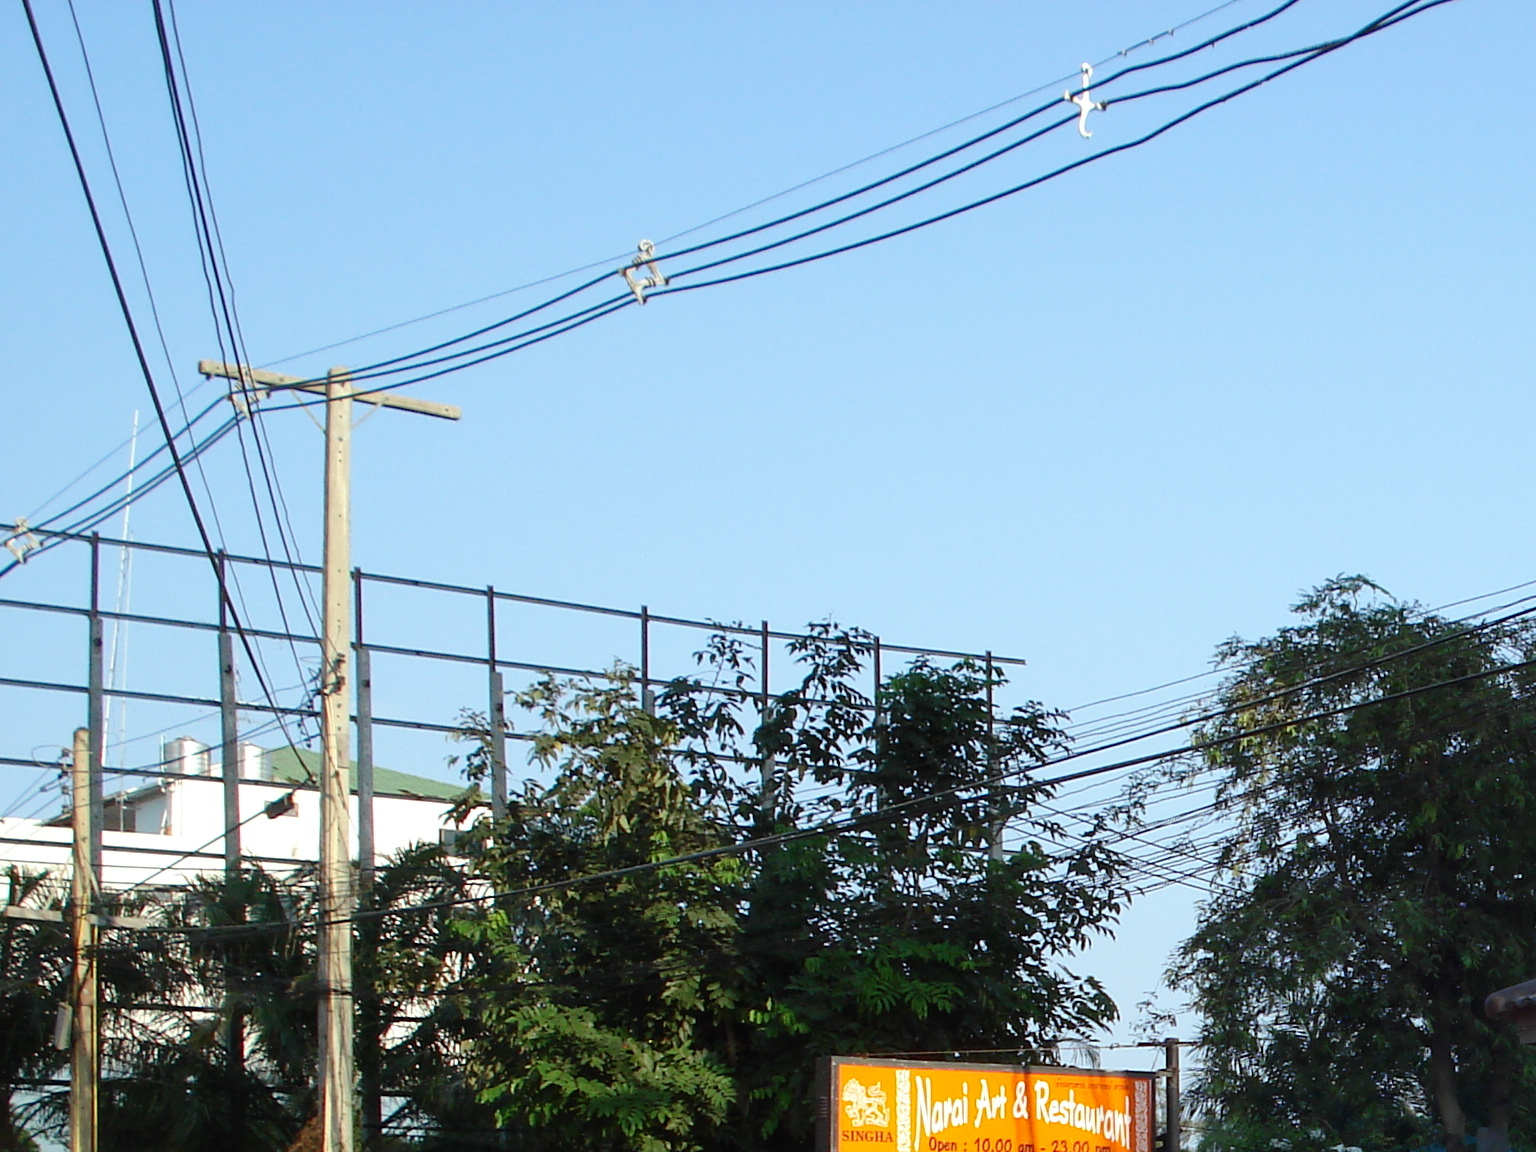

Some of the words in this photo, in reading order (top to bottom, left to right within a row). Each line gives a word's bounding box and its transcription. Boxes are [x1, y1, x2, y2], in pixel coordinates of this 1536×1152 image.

[913, 1074, 969, 1152] Narai
[973, 1078, 1008, 1129] Art
[1012, 1080, 1029, 1120] &
[1033, 1079, 1132, 1151] Restaurant
[841, 1130, 894, 1143] SINGHA
[974, 1138, 1013, 1152] 10.00
